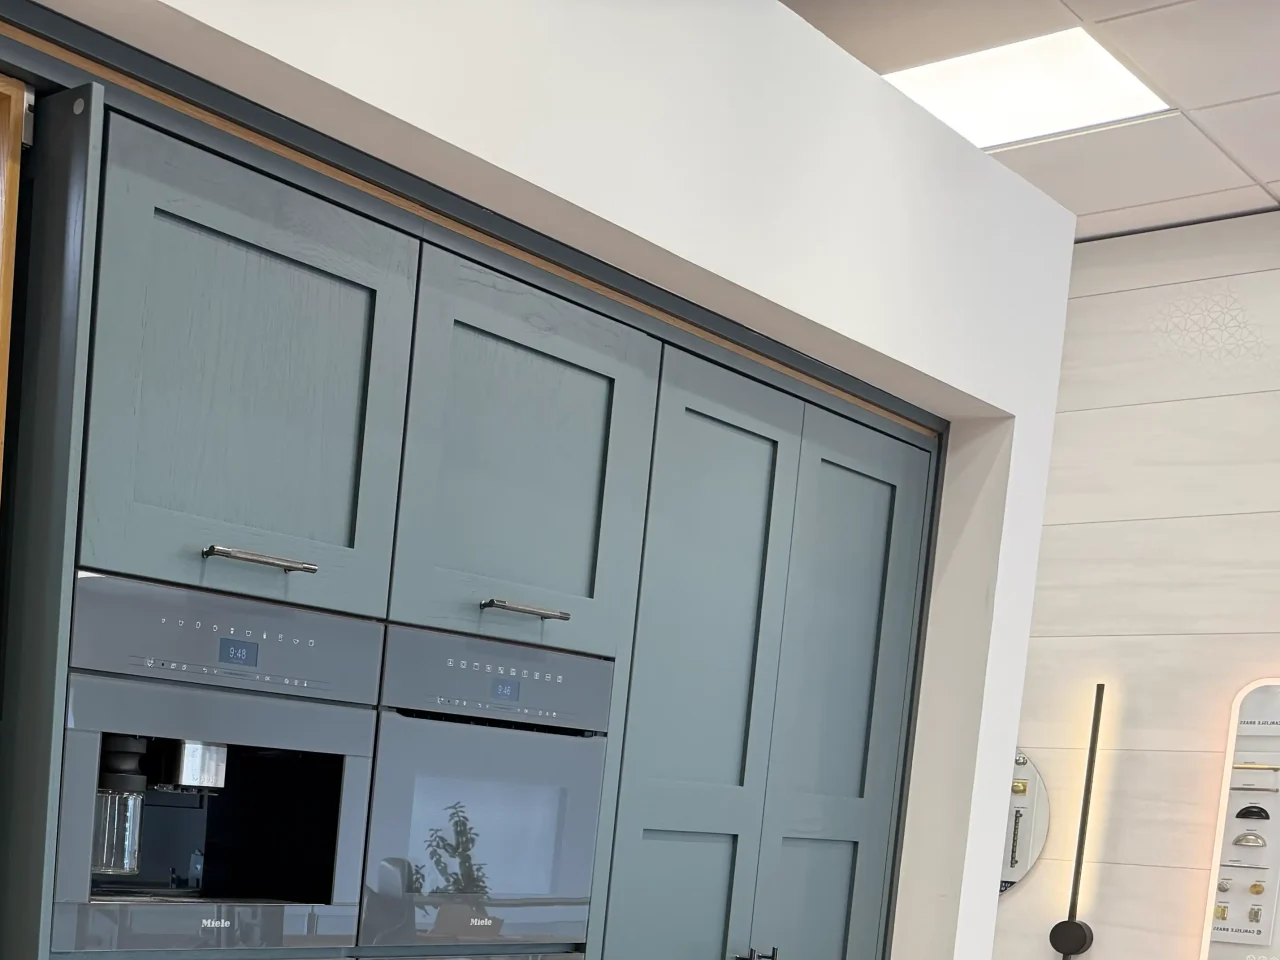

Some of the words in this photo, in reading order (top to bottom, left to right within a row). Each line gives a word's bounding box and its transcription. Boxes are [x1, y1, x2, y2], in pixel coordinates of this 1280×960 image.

[229, 647, 247, 660] 9:48
[202, 918, 231, 928] Miele
[470, 917, 493, 927] Miele
